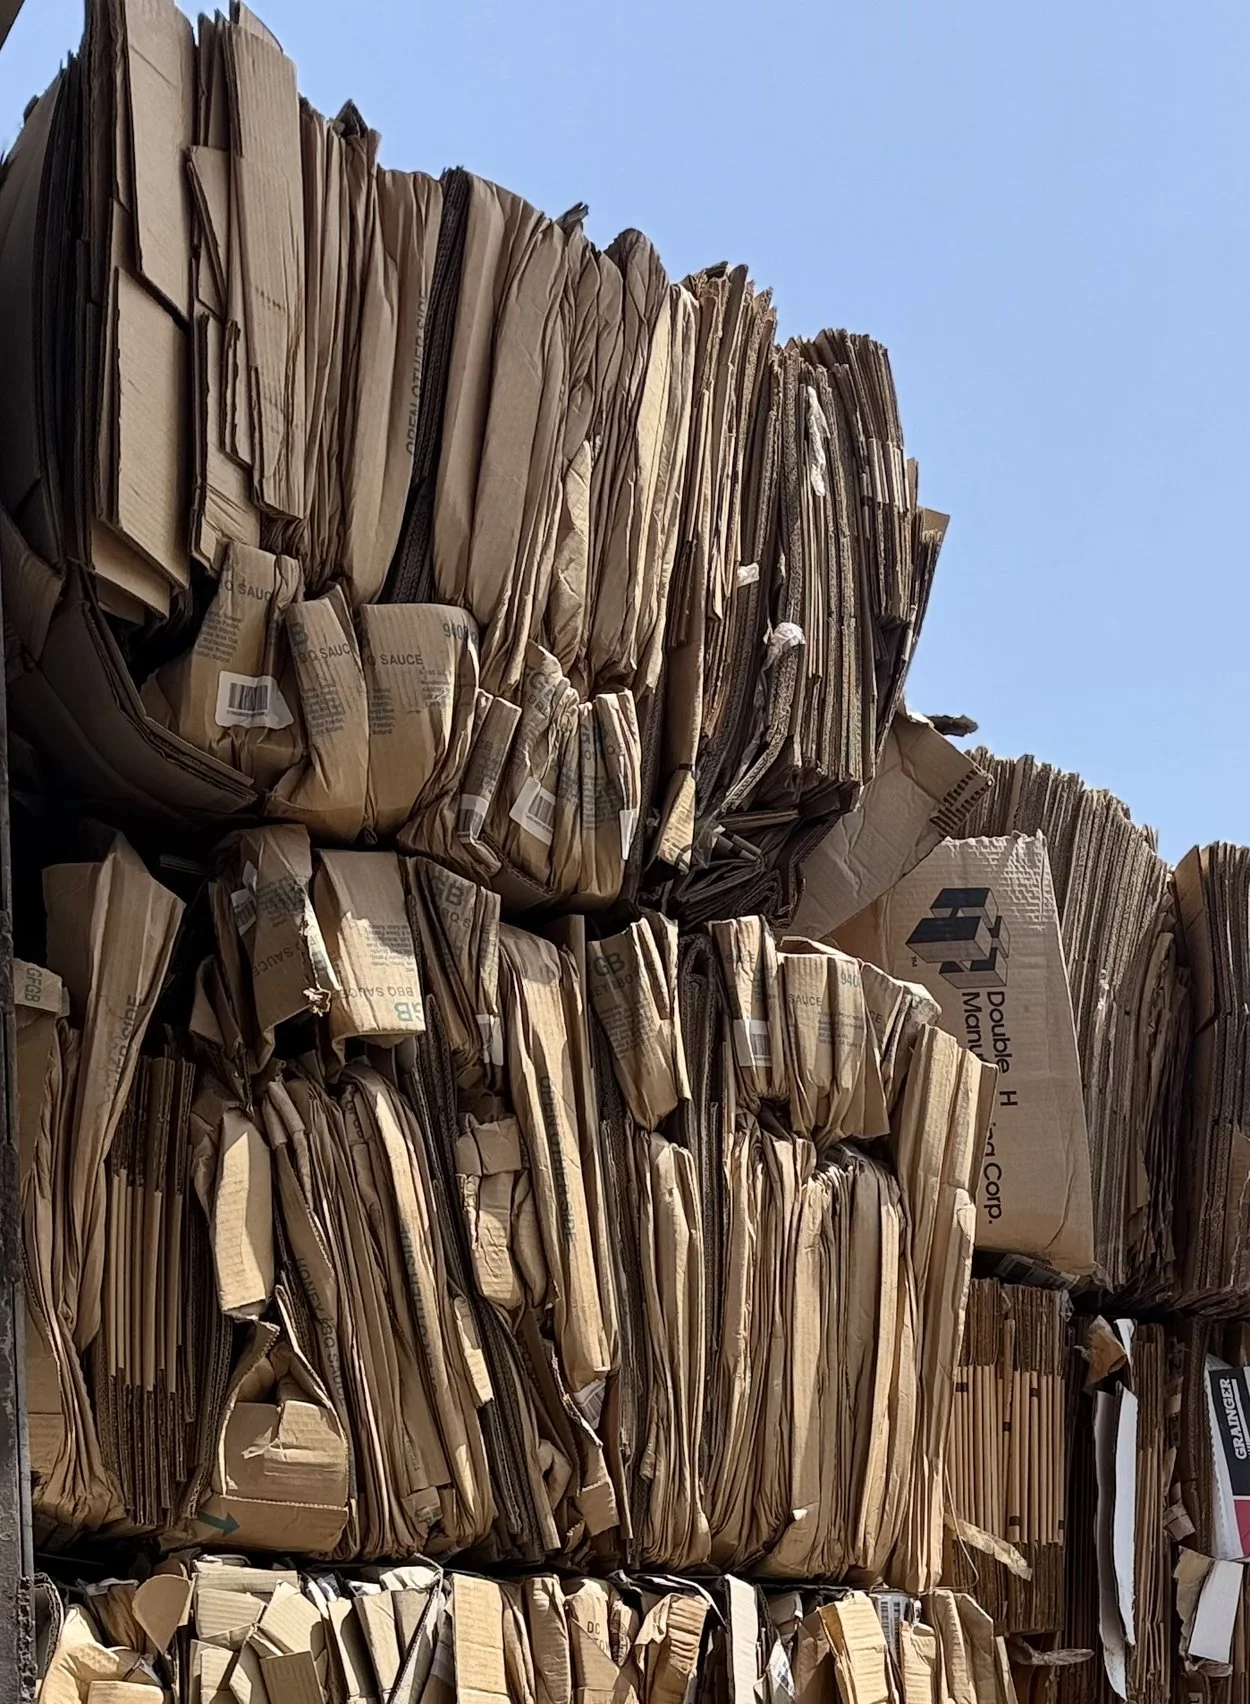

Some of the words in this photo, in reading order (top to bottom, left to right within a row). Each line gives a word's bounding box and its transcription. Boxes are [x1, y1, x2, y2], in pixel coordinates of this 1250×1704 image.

[380, 653, 424, 666] SAUCE
[388, 986, 413, 997] BBQ
[789, 994, 822, 1007] SAUCE
[986, 991, 1012, 1074] Double
[999, 1090, 1018, 1107] H
[982, 1162, 1002, 1225] Corp.
[1220, 1378, 1247, 1459] GRAINGER
